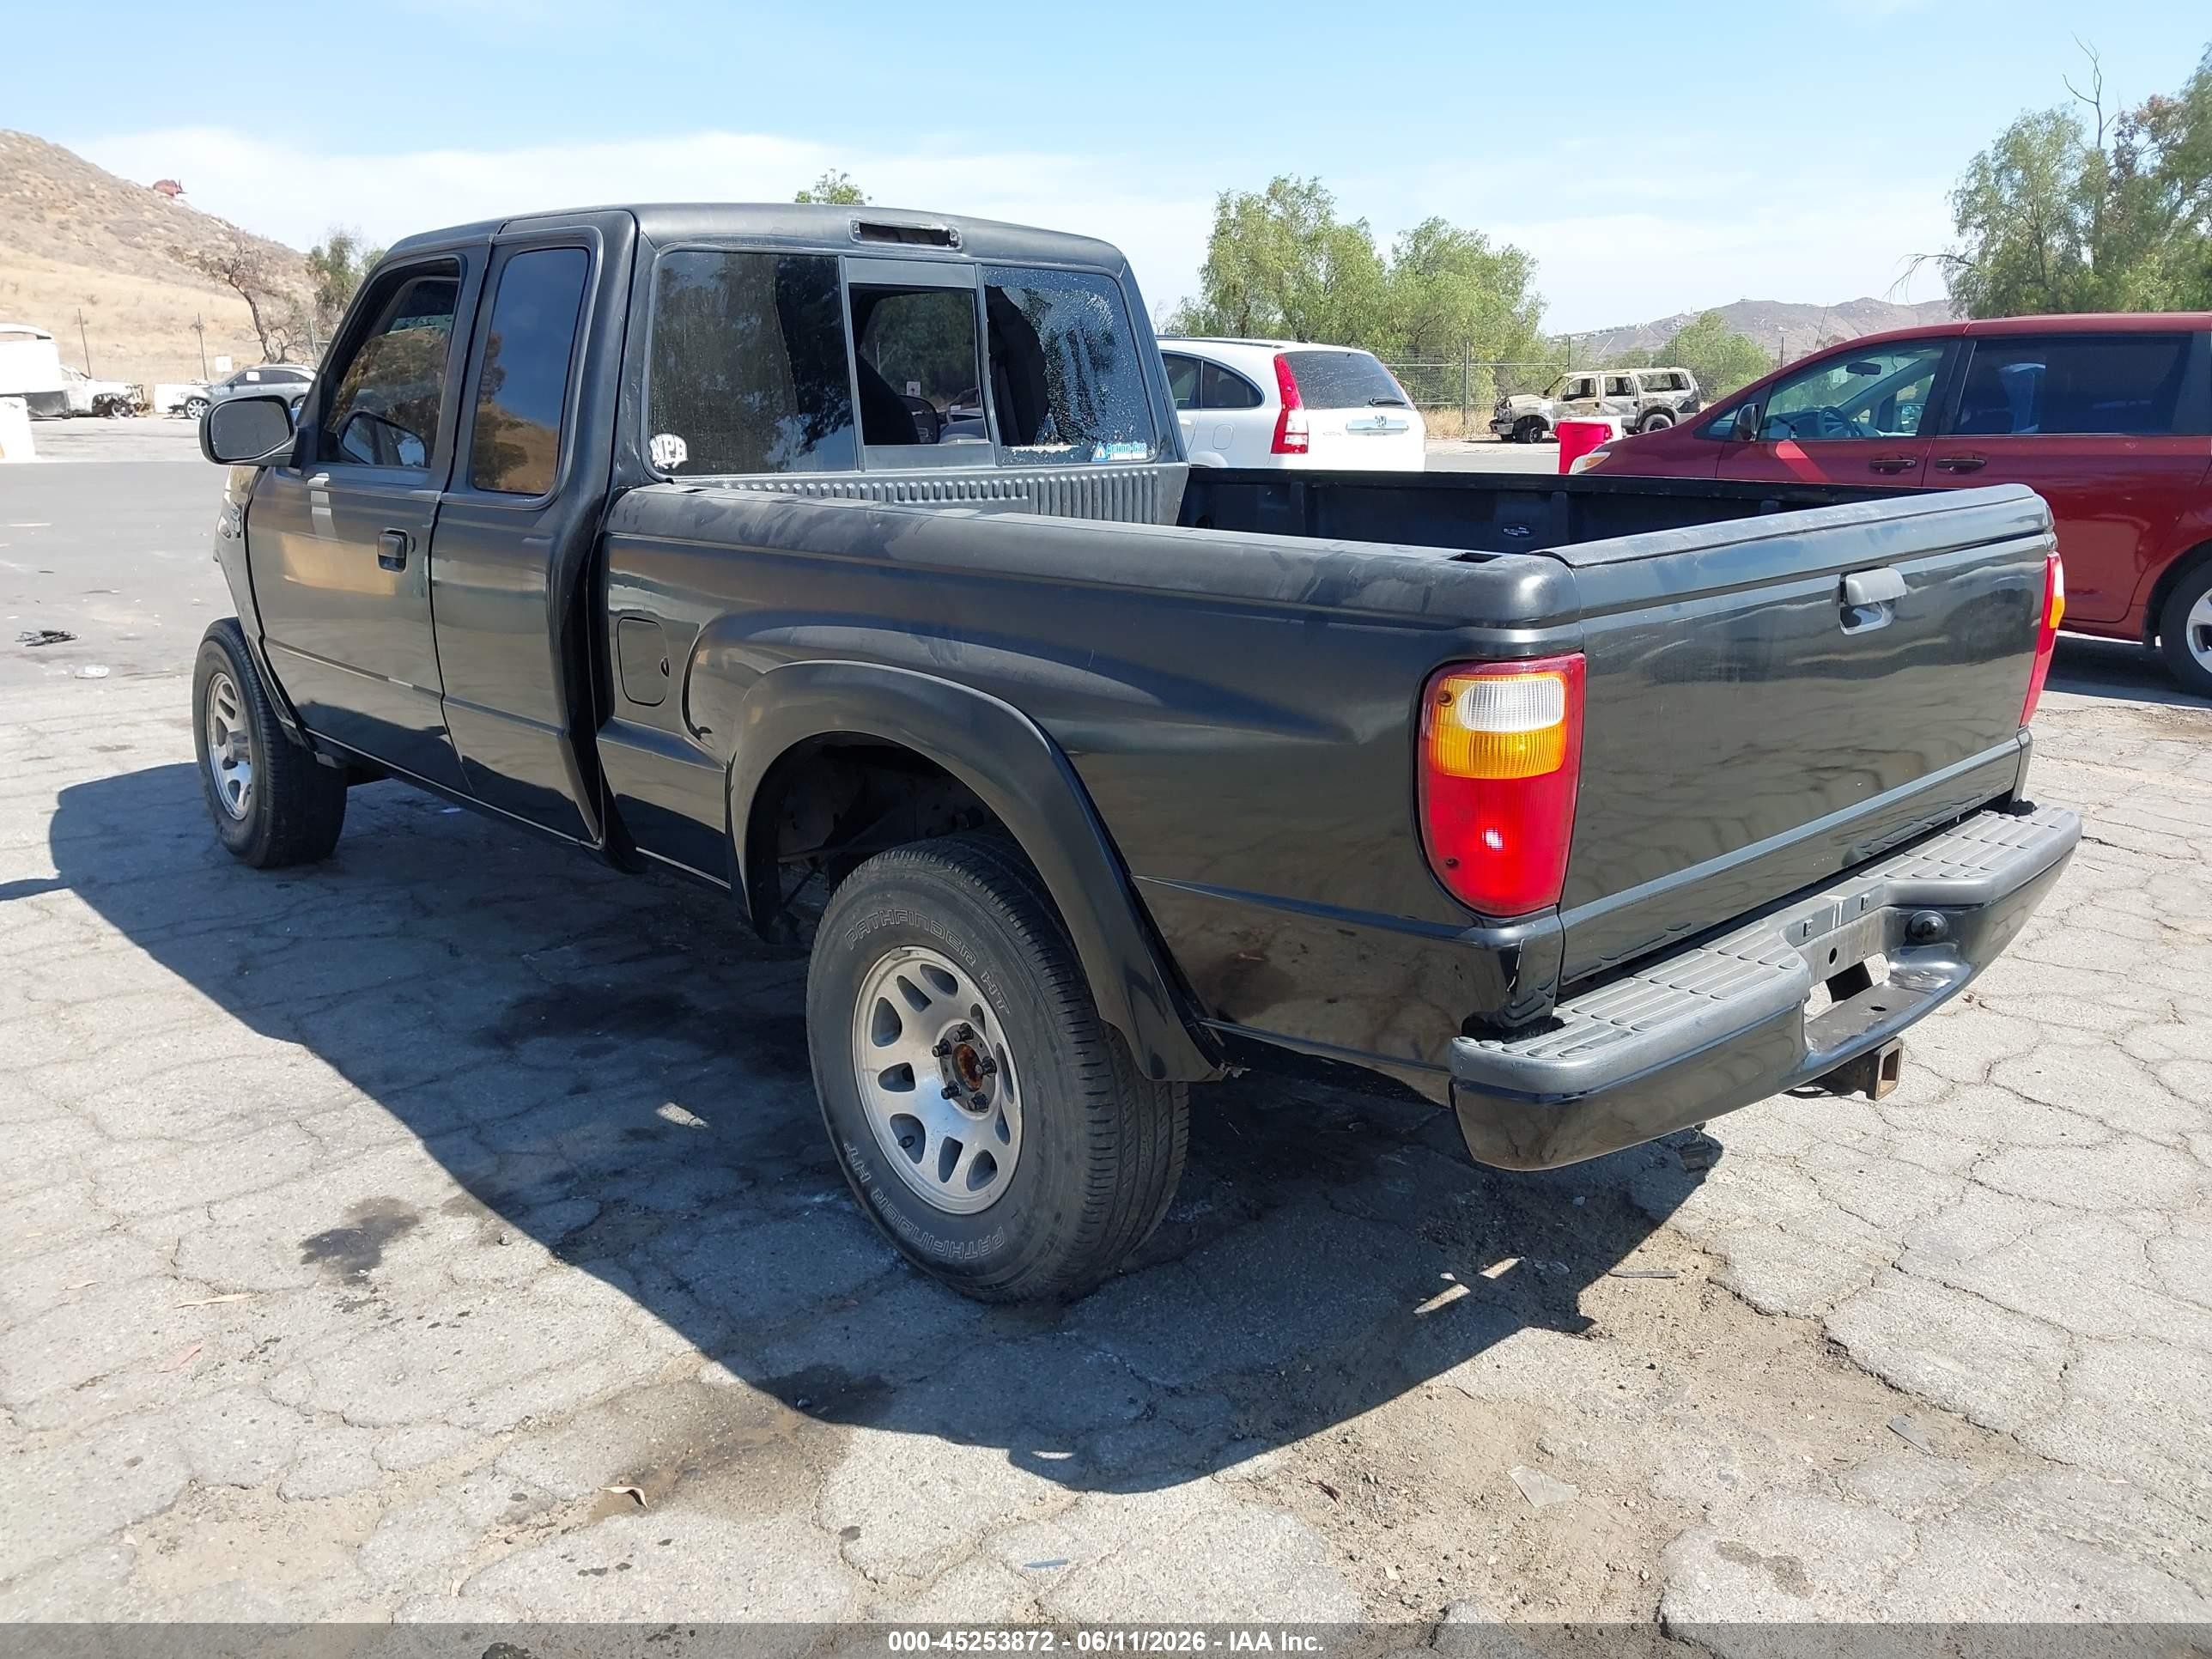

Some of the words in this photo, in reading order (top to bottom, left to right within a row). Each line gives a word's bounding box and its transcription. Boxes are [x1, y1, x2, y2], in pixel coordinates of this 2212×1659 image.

[845, 908, 976, 968] PATHFINDER
[981, 970, 1011, 1015] HT
[843, 1142, 872, 1183] HT
[871, 1187, 1006, 1260] PATHFINDER
